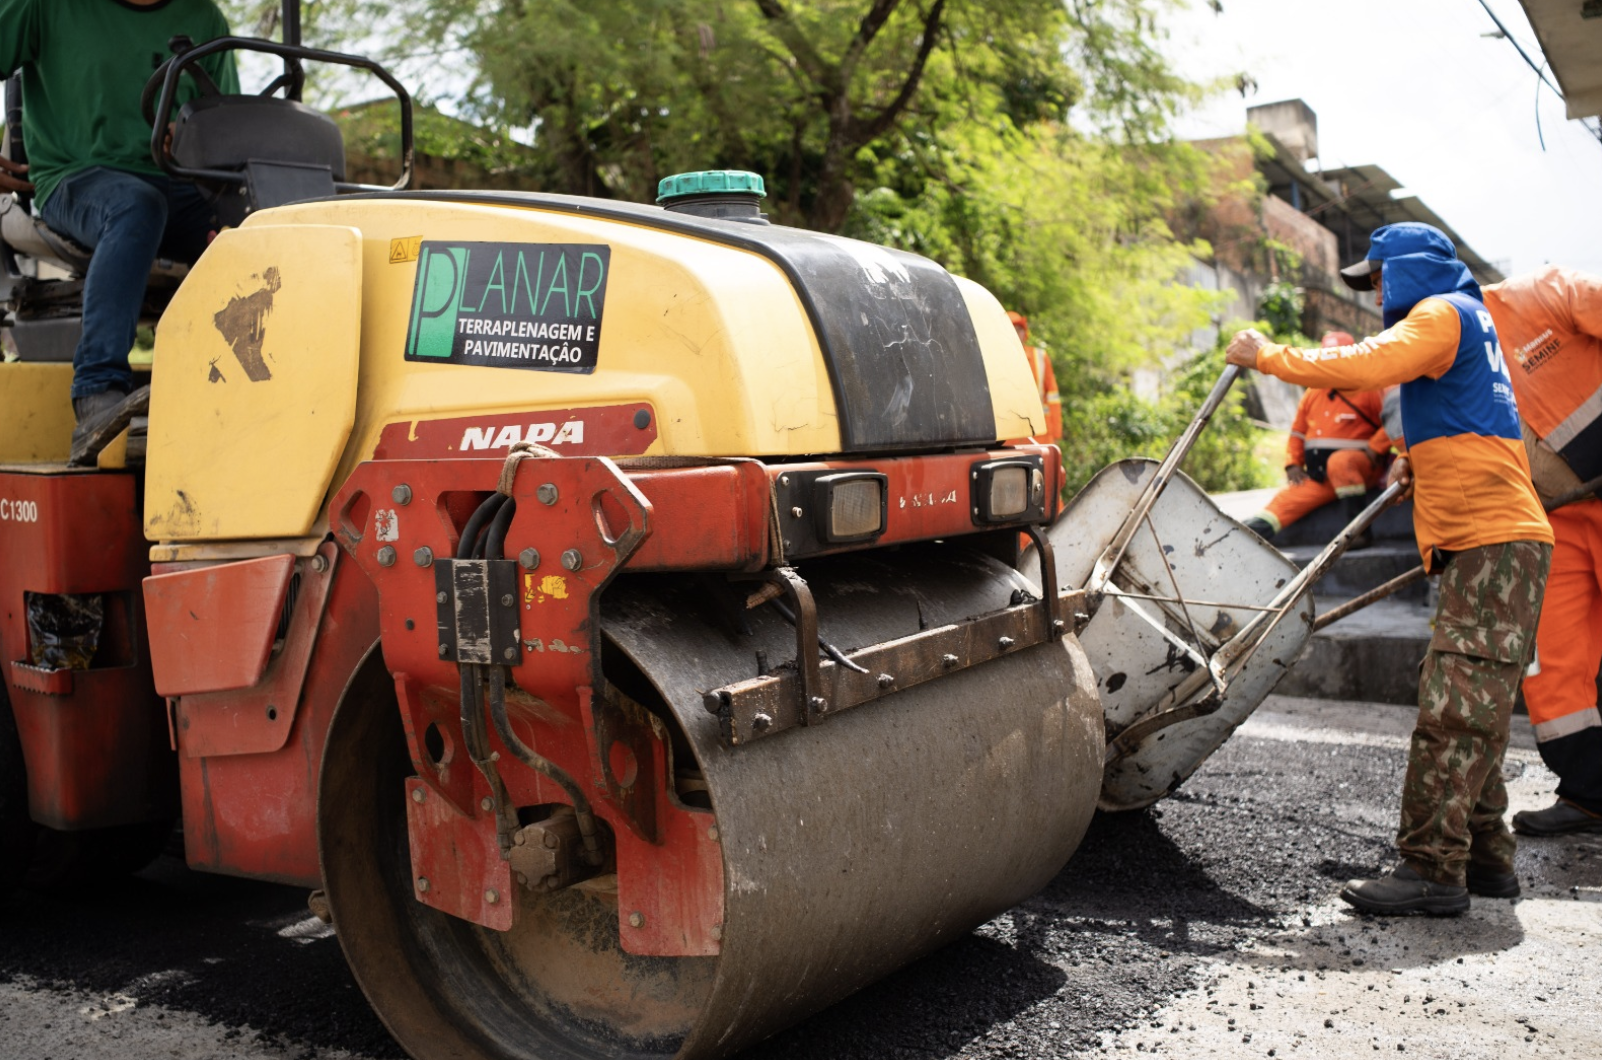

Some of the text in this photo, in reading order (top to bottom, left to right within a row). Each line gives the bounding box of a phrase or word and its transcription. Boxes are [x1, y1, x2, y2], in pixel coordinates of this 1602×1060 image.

[408, 247, 604, 357] PLANAR
[458, 318, 595, 342] TERRAPLENAGEM E
[1522, 338, 1560, 370] SEMINF
[459, 420, 584, 451] NAPA
[0, 498, 38, 522] C1300
